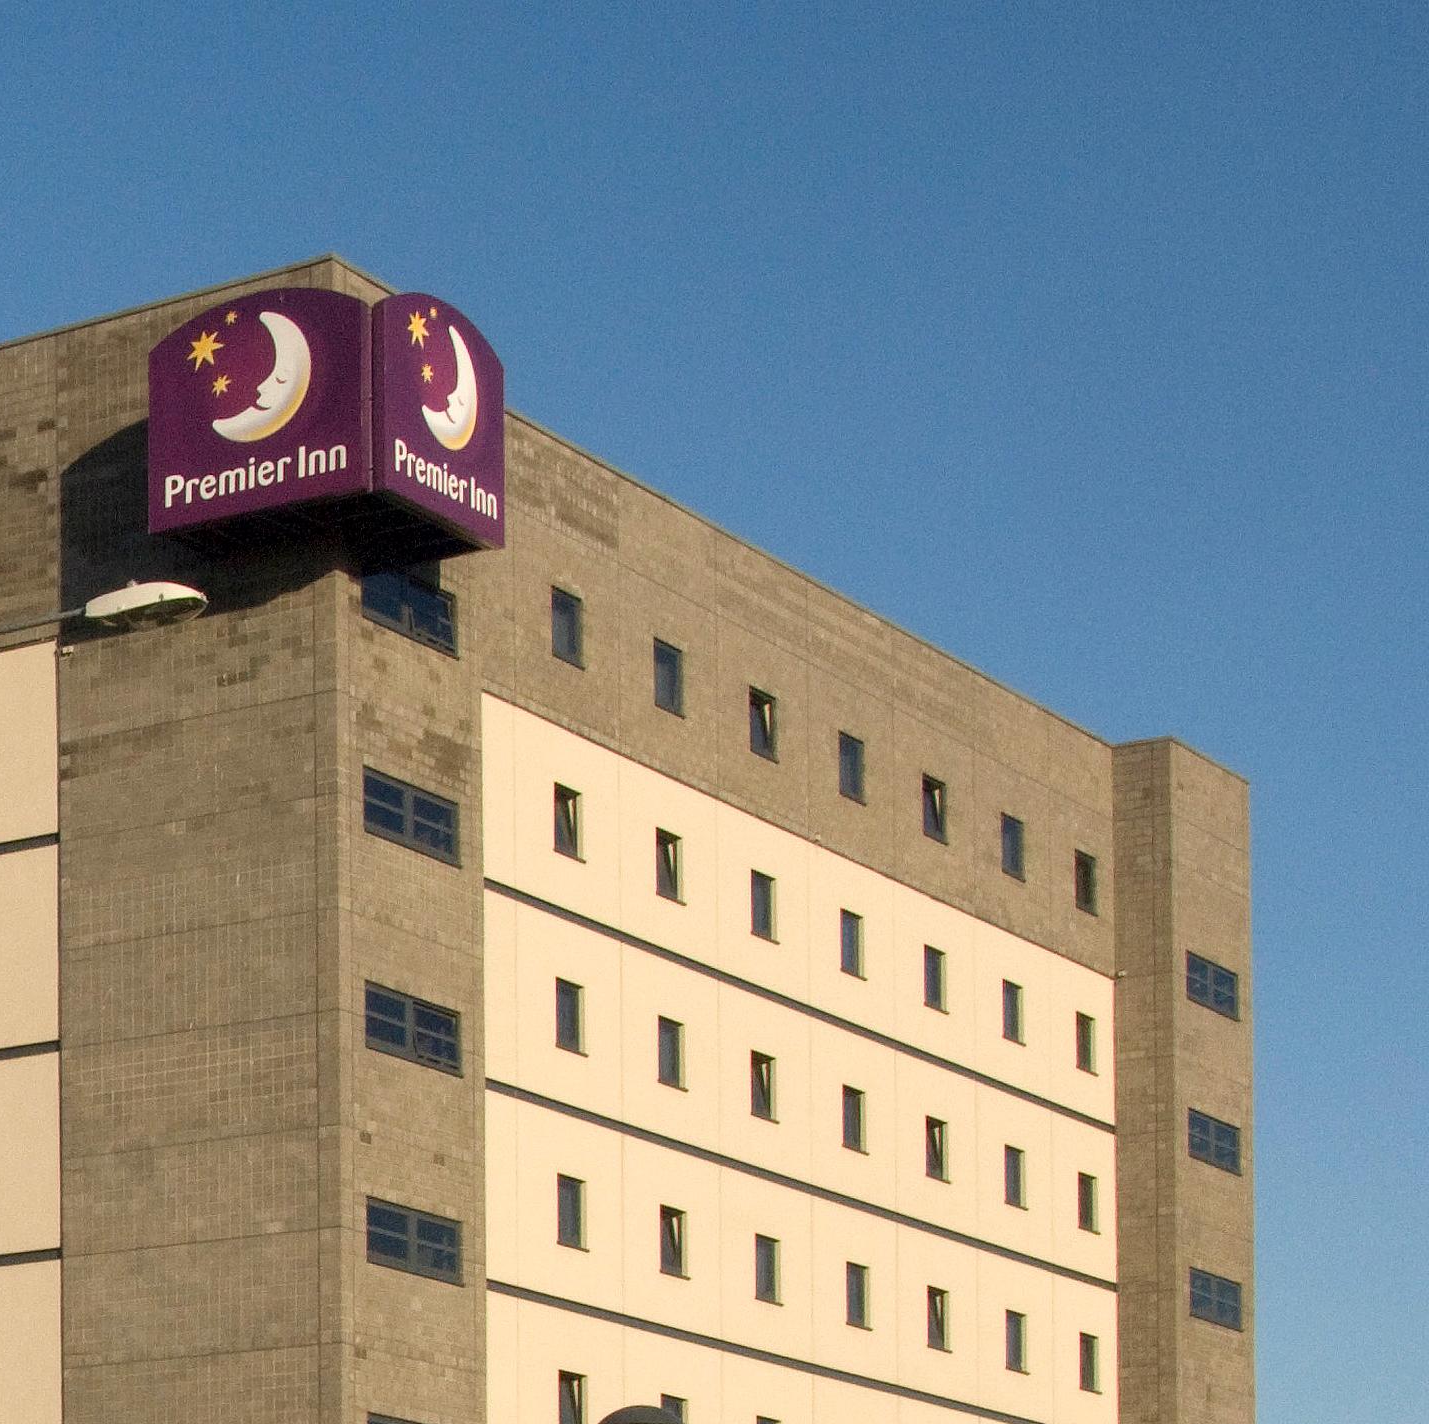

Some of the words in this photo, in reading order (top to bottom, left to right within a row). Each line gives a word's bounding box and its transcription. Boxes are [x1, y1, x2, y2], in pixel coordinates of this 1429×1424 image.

[164, 456, 292, 508] Premier
[298, 444, 347, 479] Inn
[394, 438, 467, 504] Premier
[470, 476, 498, 520] Inn
